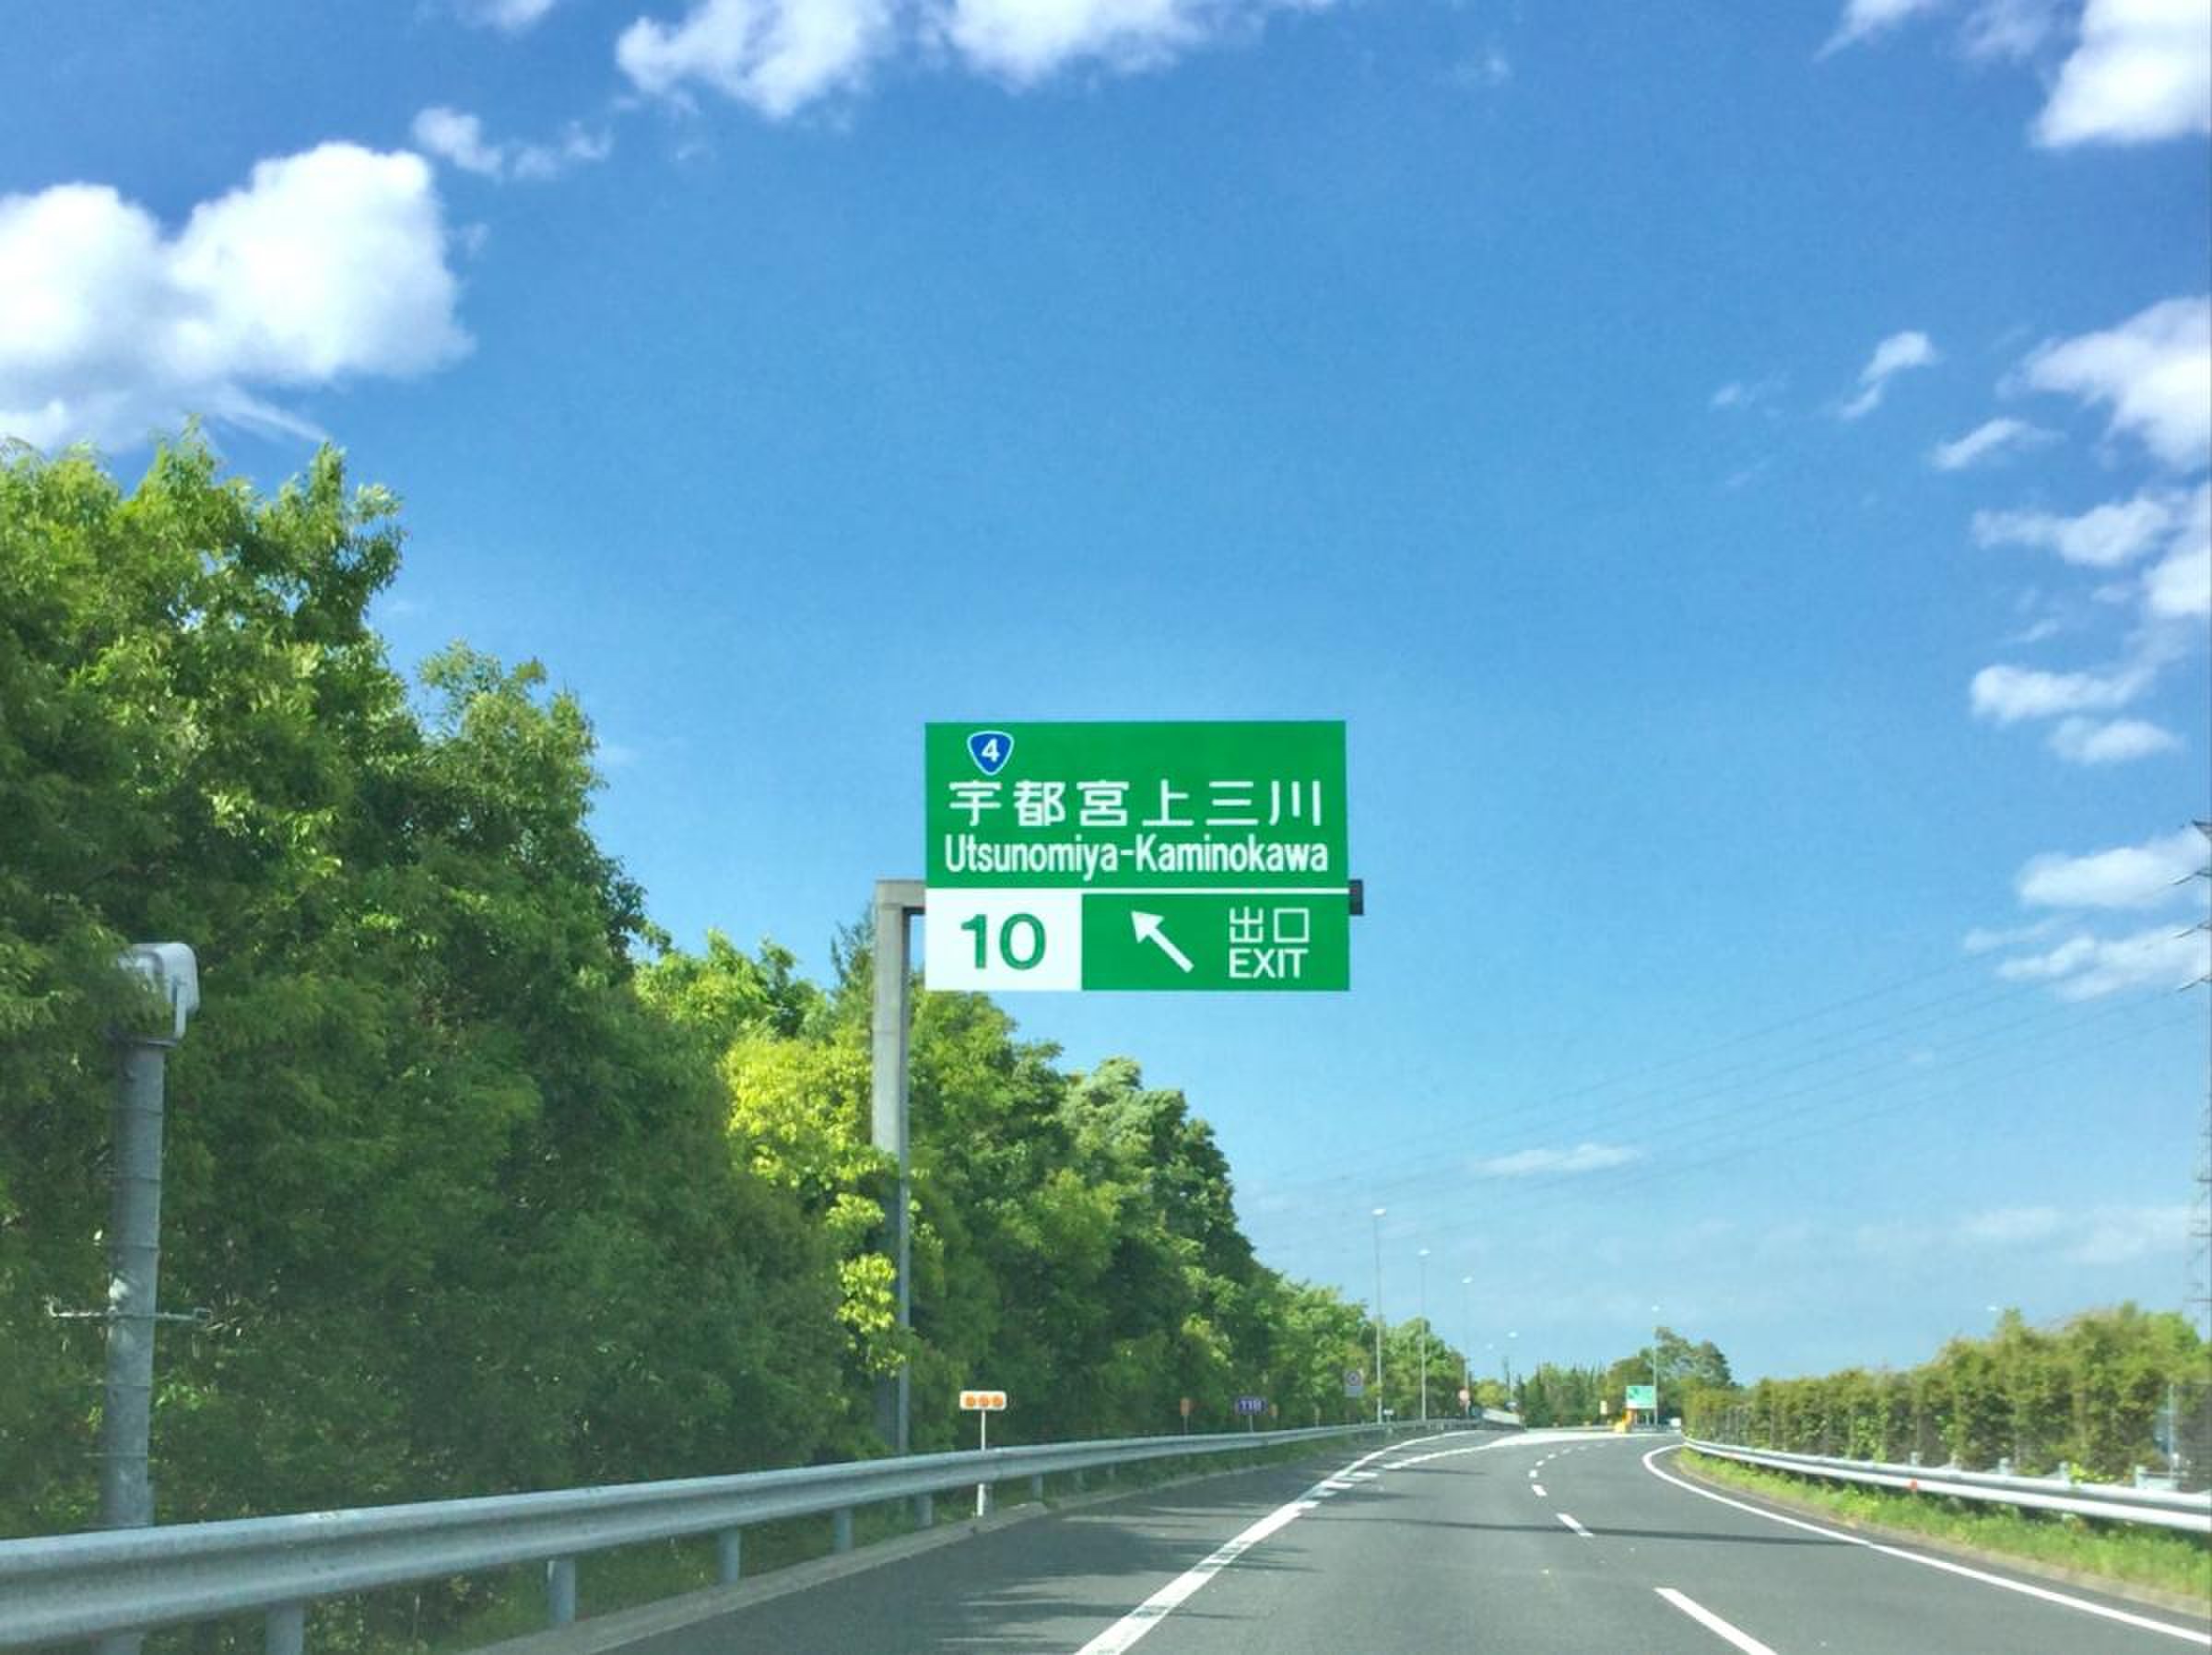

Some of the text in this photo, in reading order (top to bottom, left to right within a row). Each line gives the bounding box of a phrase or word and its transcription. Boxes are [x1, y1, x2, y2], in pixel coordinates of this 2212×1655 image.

[982, 739, 1000, 763] 4
[948, 779, 1322, 828] 宇都宮上三川
[945, 833, 1329, 881] Utsunomiya-Kaminokawa
[960, 912, 1046, 970] 10
[1229, 906, 1310, 945] 出口
[1229, 948, 1309, 979] EXIT
